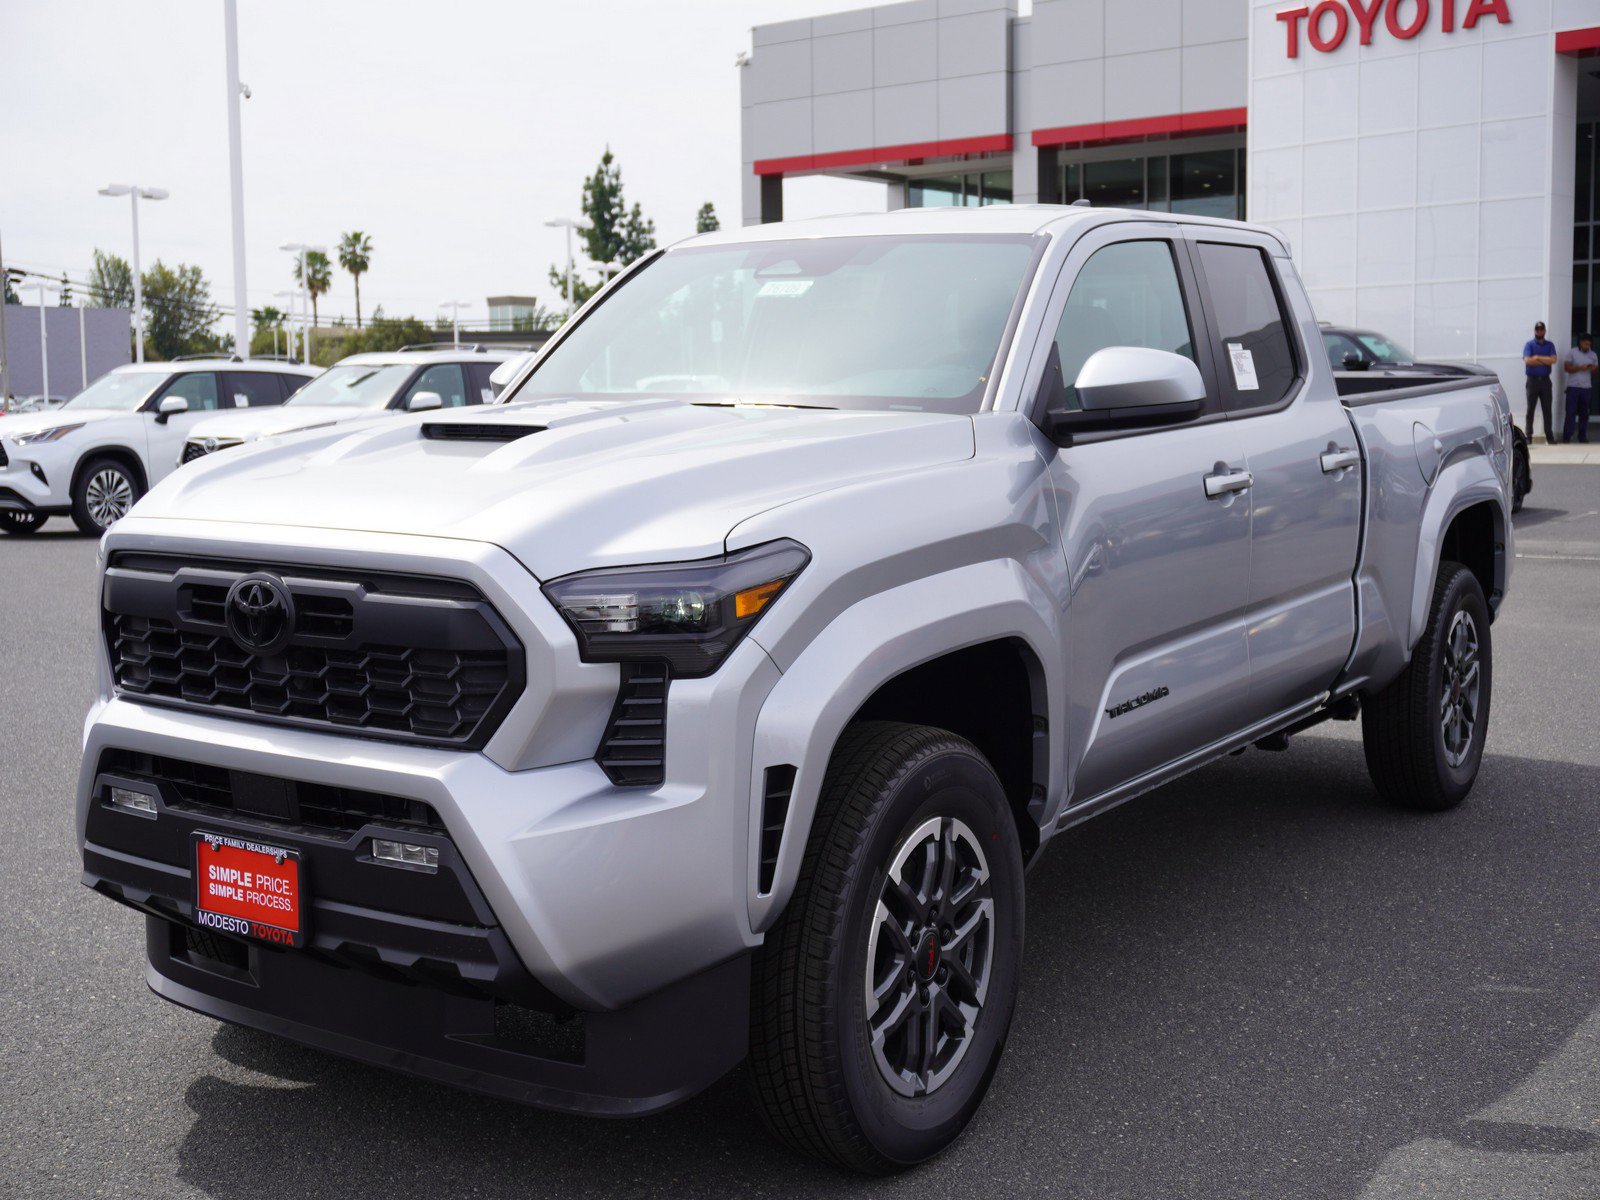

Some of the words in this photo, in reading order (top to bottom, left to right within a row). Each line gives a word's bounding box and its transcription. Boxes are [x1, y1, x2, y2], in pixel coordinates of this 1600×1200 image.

[204, 834, 223, 845] PRICE
[224, 838, 245, 849] FAMILY
[246, 842, 288, 858] DEALERSHIPS
[208, 864, 252, 888] SIMPLE
[256, 874, 293, 895] PRICE.
[209, 882, 244, 901] SIMPLE
[246, 890, 293, 912] PROCESS.
[198, 911, 249, 934] MODESTO
[252, 923, 294, 945] TOYOTA
